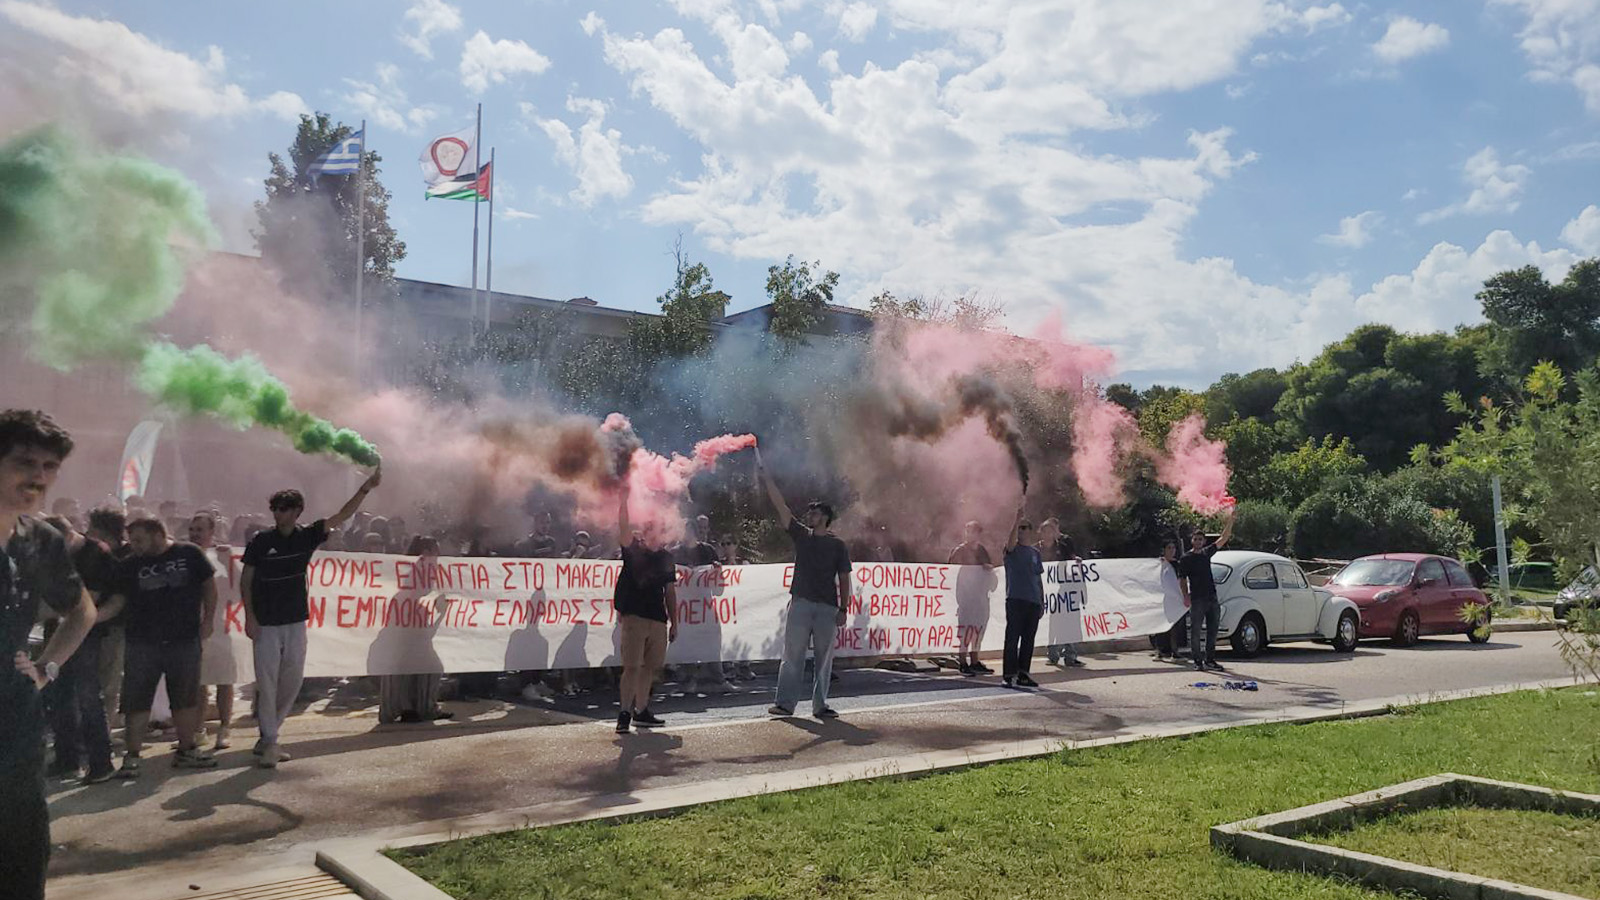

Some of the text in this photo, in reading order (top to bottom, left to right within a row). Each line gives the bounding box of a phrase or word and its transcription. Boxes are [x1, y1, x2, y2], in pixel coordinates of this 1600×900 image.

[395, 560, 490, 590] ΕΝΑΝΤΙΑ
[501, 561, 545, 591] ΣΤΟ
[673, 569, 692, 587] ΩΝ
[696, 567, 743, 588] ΛΑΩΝ
[856, 564, 952, 591] ΦΟΝΙΑΔΕΣ
[1046, 562, 1100, 584] KILLERS
[336, 595, 435, 628] ΕΜΠΛΟΚΗ
[444, 598, 484, 627] ΤΗΣ
[492, 598, 586, 626] ΕΛΛΑΔΑΣ
[677, 597, 738, 625] ΛΕΜΟ!
[846, 594, 946, 618] ΗΝ ΒΑΣΗ ΤΗΣ
[868, 626, 891, 650] ΚΑΙ
[898, 627, 925, 648] ΤΟΥ
[928, 624, 984, 649] ΑΡΑΞΟΥ
[1083, 611, 1116, 638] ΚΝΕ
